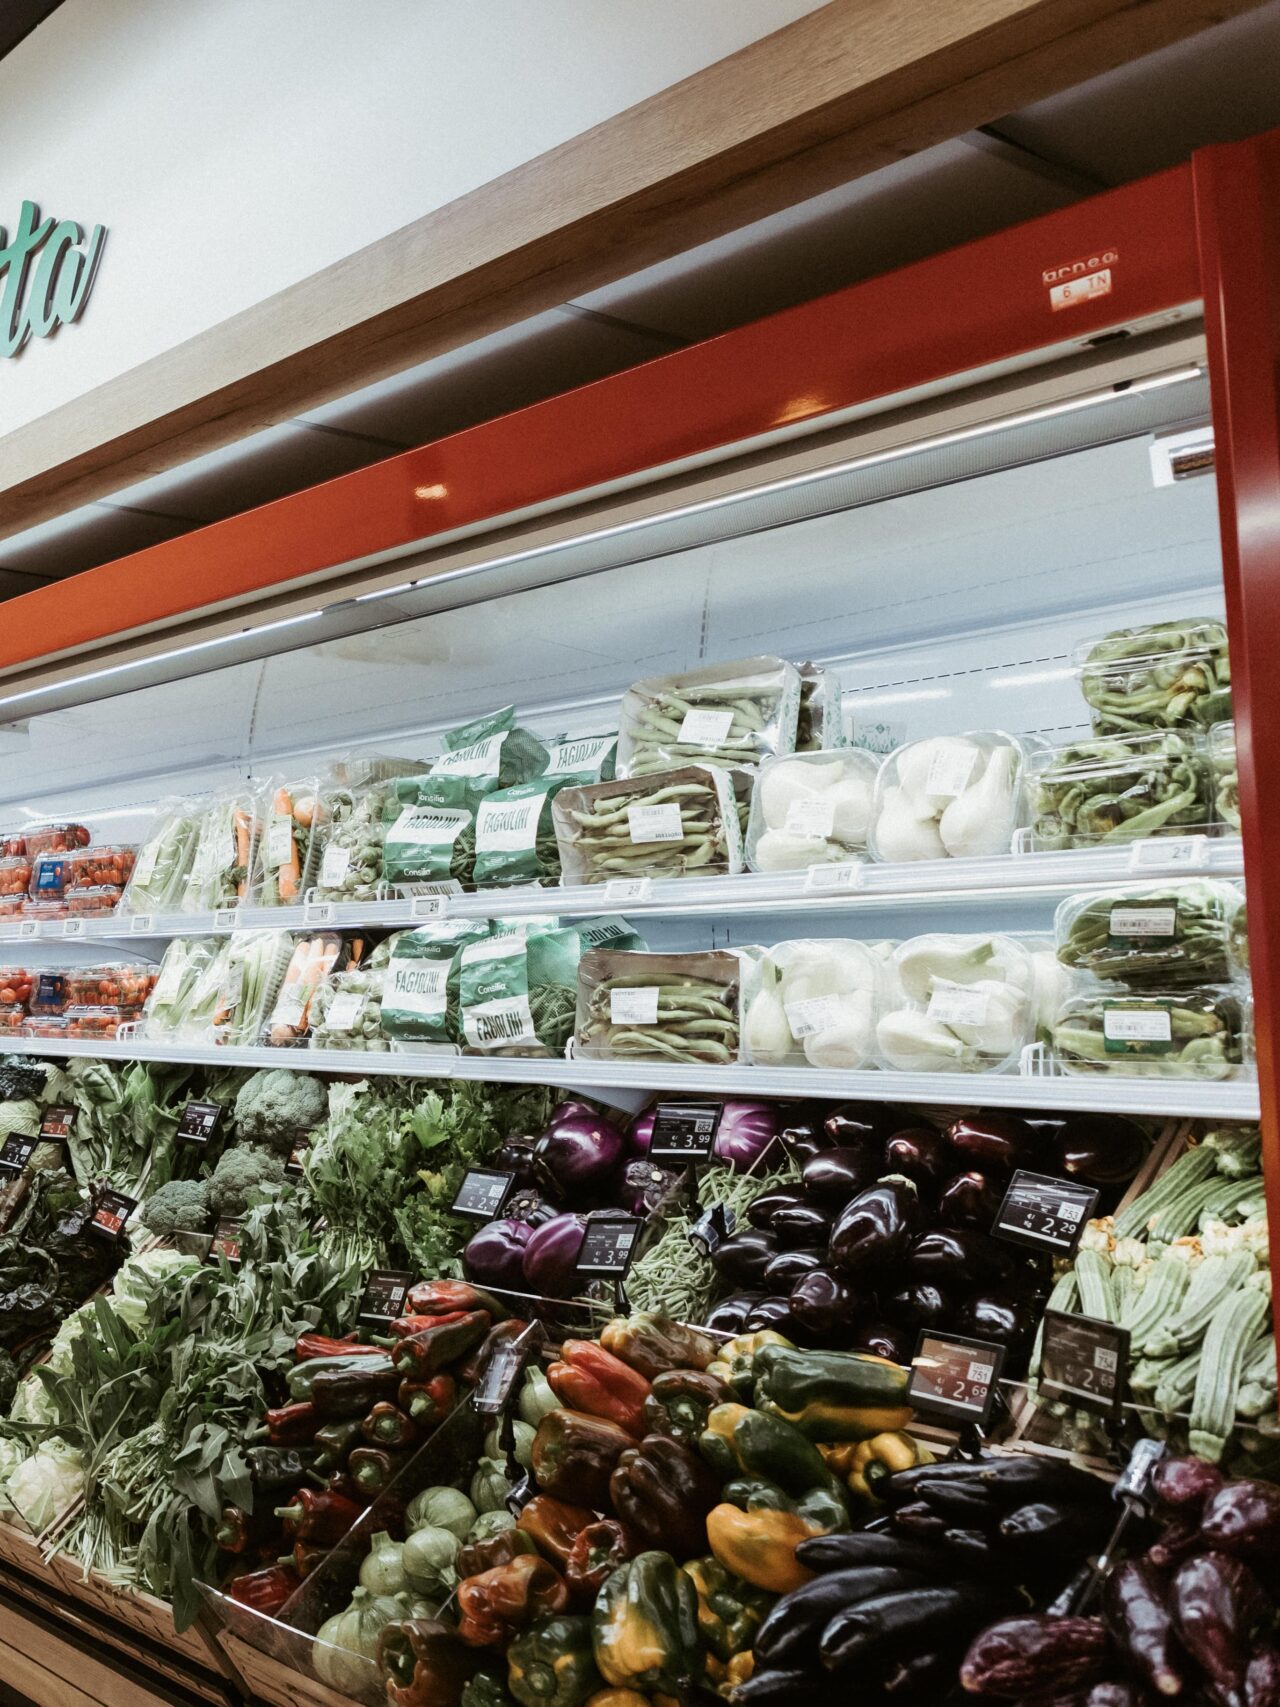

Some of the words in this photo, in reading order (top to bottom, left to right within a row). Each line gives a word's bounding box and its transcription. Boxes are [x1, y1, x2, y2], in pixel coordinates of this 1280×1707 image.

[556, 740, 605, 769] FAGIOLINI
[417, 791, 445, 803] Consilia
[403, 815, 460, 830] FAGIOLINI
[481, 806, 532, 834] FAGIOLINI
[403, 867, 431, 877] Consilia
[395, 969, 439, 994] FAGIOLINI
[477, 982, 506, 995] Consilia
[476, 1010, 524, 1041] FAGIOLINI
[697, 1124, 710, 1132] 662
[684, 1134, 711, 1149] 3,99
[478, 1197, 499, 1210] 2,49
[1062, 1208, 1080, 1221] 753
[1040, 1217, 1077, 1237] 2,29
[605, 1250, 629, 1265] 3,99
[382, 1302, 400, 1315] 4,29
[1097, 1357, 1115, 1370] 754
[972, 1369, 990, 1382] 751
[1082, 1368, 1116, 1394] 2,69
[952, 1381, 988, 1403] 2,69
